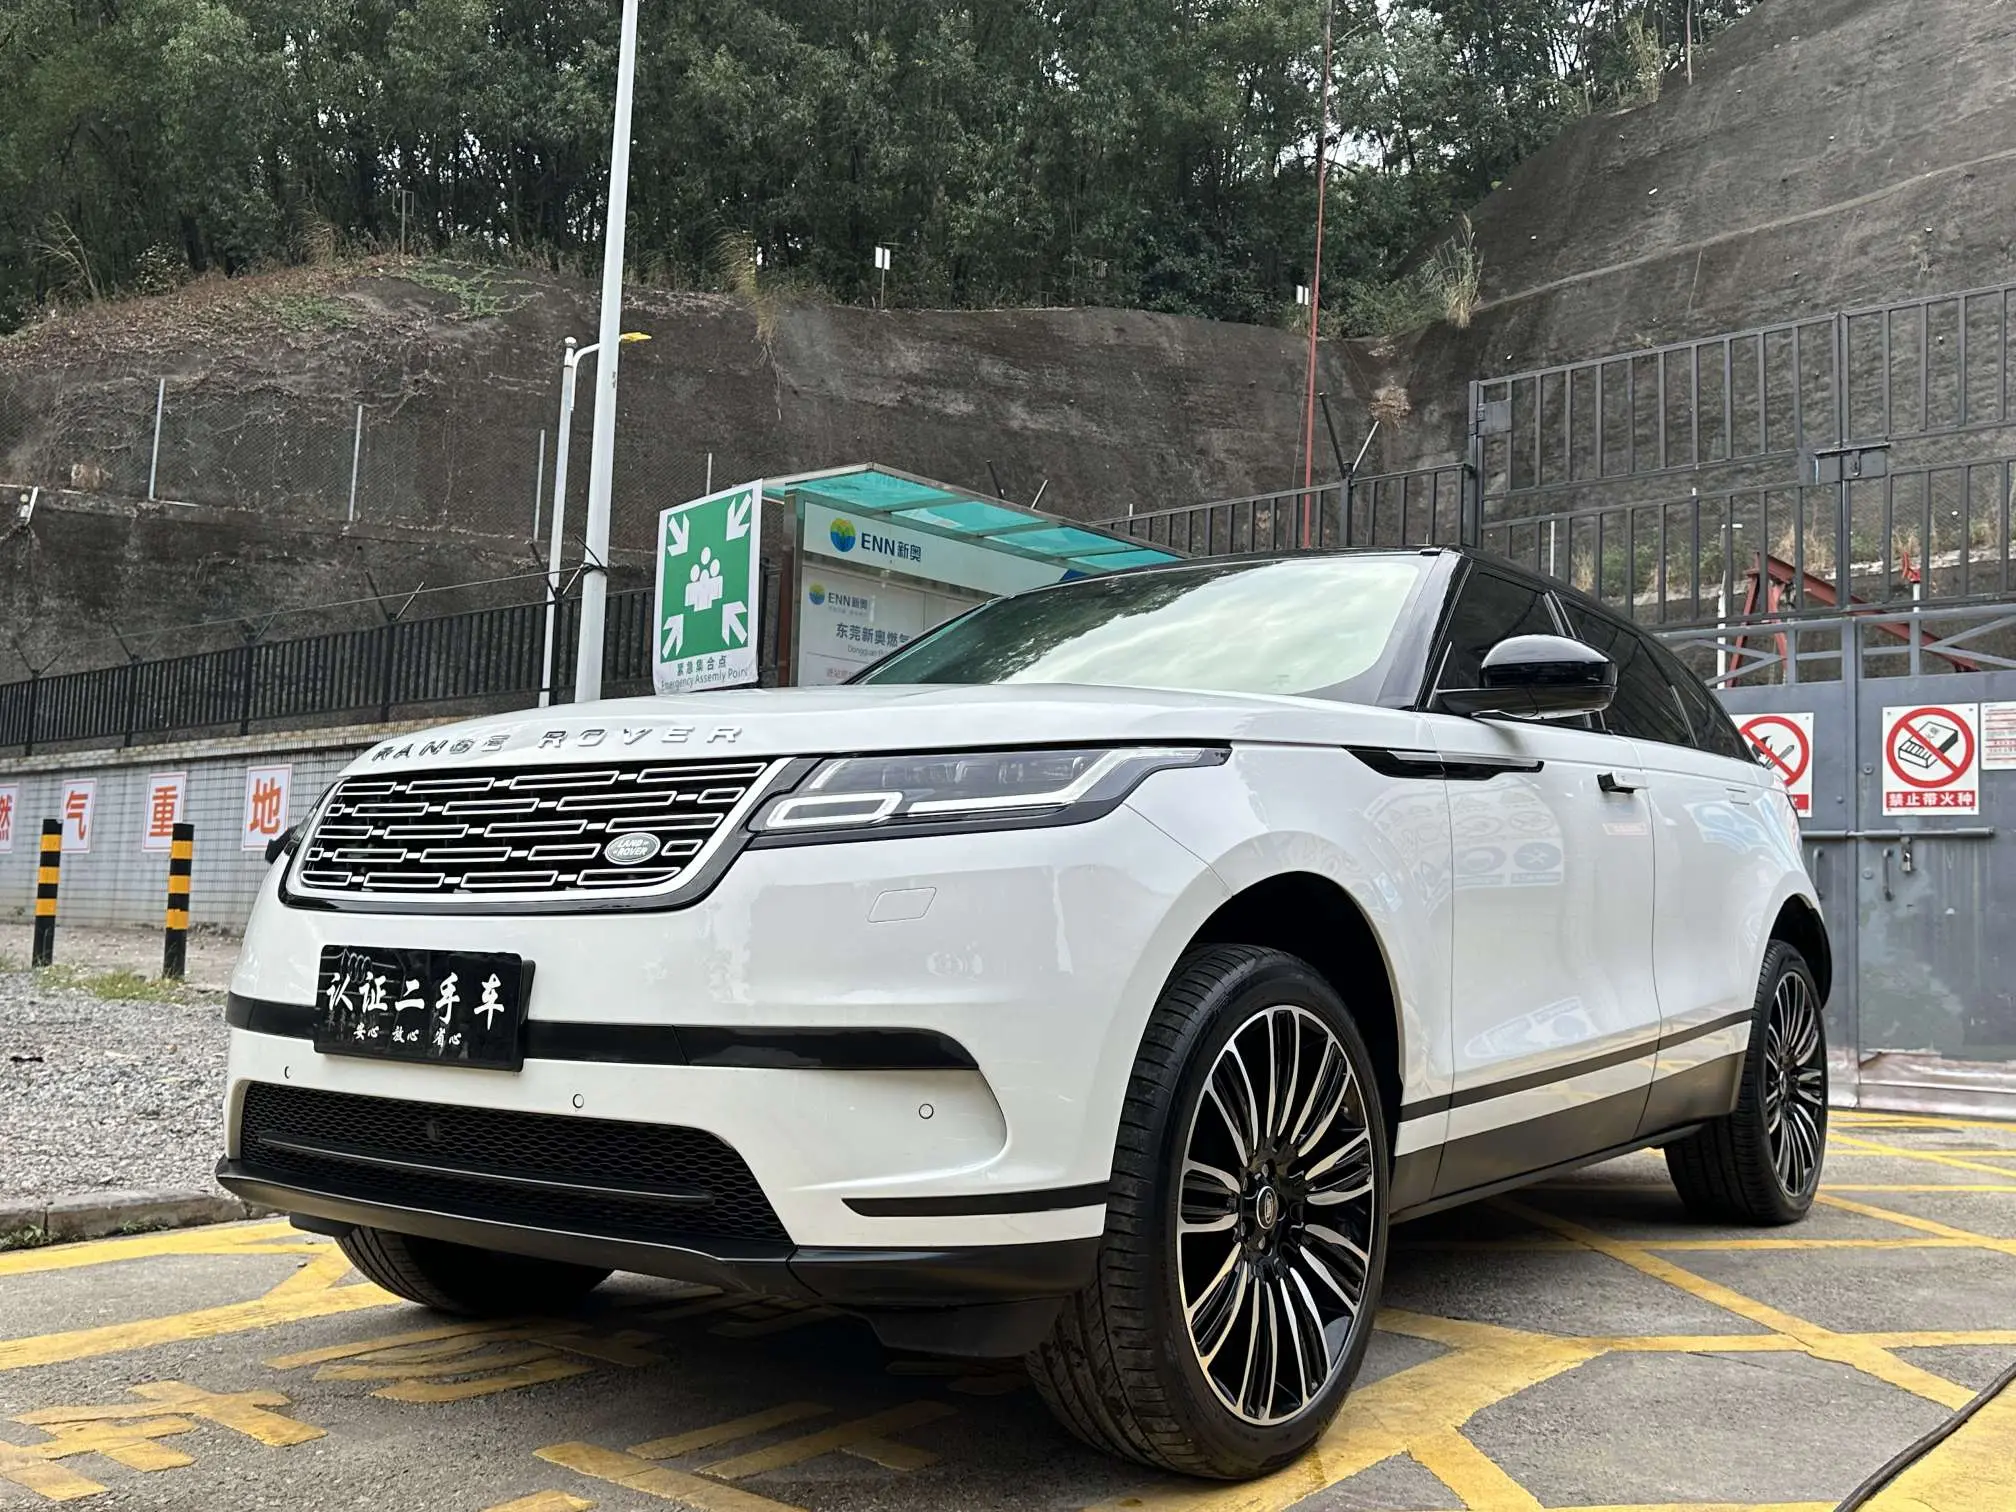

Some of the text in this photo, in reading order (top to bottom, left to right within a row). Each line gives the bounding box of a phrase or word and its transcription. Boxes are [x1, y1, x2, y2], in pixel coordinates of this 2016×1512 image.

[861, 532, 922, 562] ENN新奥
[371, 726, 743, 762] RANGE ROVER
[1889, 791, 1973, 807] 禁止带火种
[616, 847, 648, 856] ROVER
[617, 839, 643, 848] LAND
[326, 971, 505, 1031] 认证二手车
